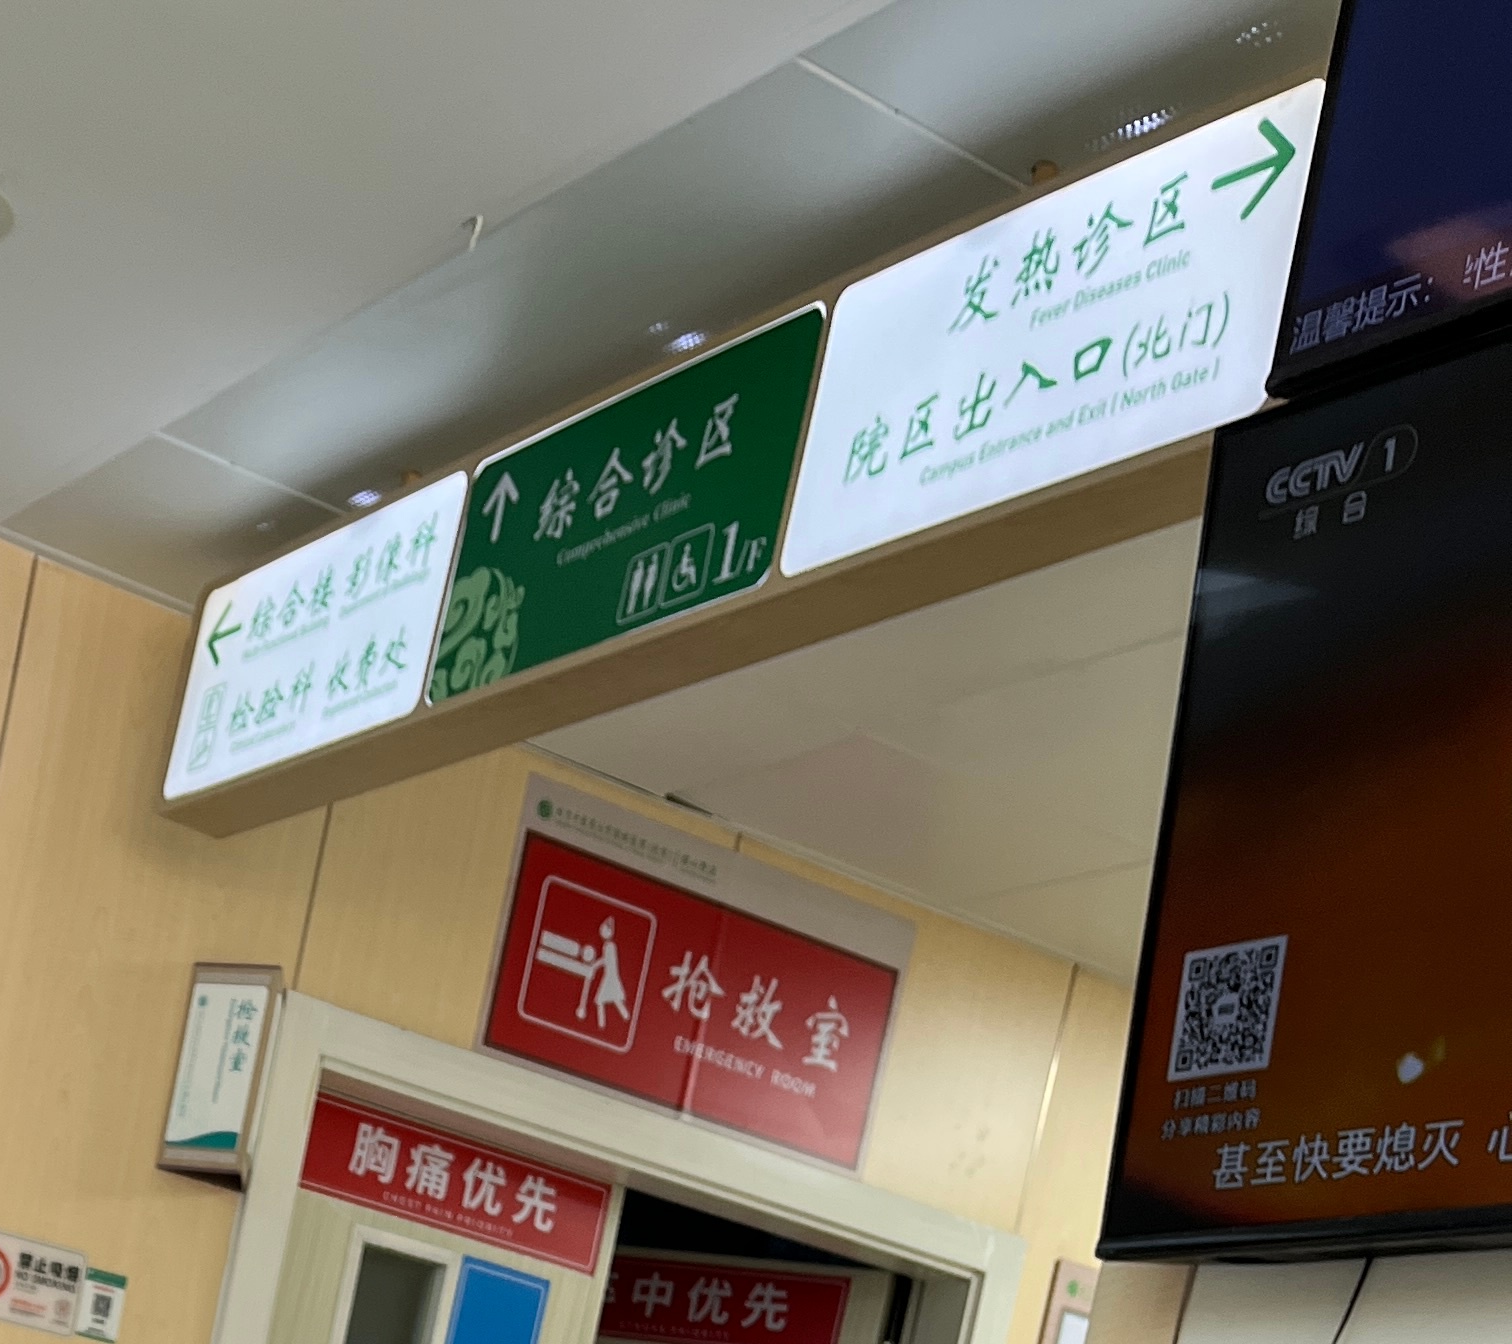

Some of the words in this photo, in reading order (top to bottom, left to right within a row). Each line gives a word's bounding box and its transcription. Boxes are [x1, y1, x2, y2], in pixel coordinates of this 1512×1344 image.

[947, 172, 1189, 334] 发热诊区
[1073, 269, 1142, 312] Diseases
[1145, 249, 1192, 281] Clinic
[533, 393, 739, 541] 综合诊区
[918, 452, 975, 486] Campus
[978, 426, 1041, 462] Entrance
[1044, 411, 1076, 438] and
[1265, 441, 1365, 504] CCTV
[327, 624, 407, 697] 收费处
[661, 950, 851, 1073] 抢救室
[673, 1034, 767, 1080] EMERGENCY
[770, 1068, 817, 1098] ROOM
[348, 1122, 558, 1234] 胸痛优先
[1213, 1118, 1465, 1190] 甚至快要熄灭
